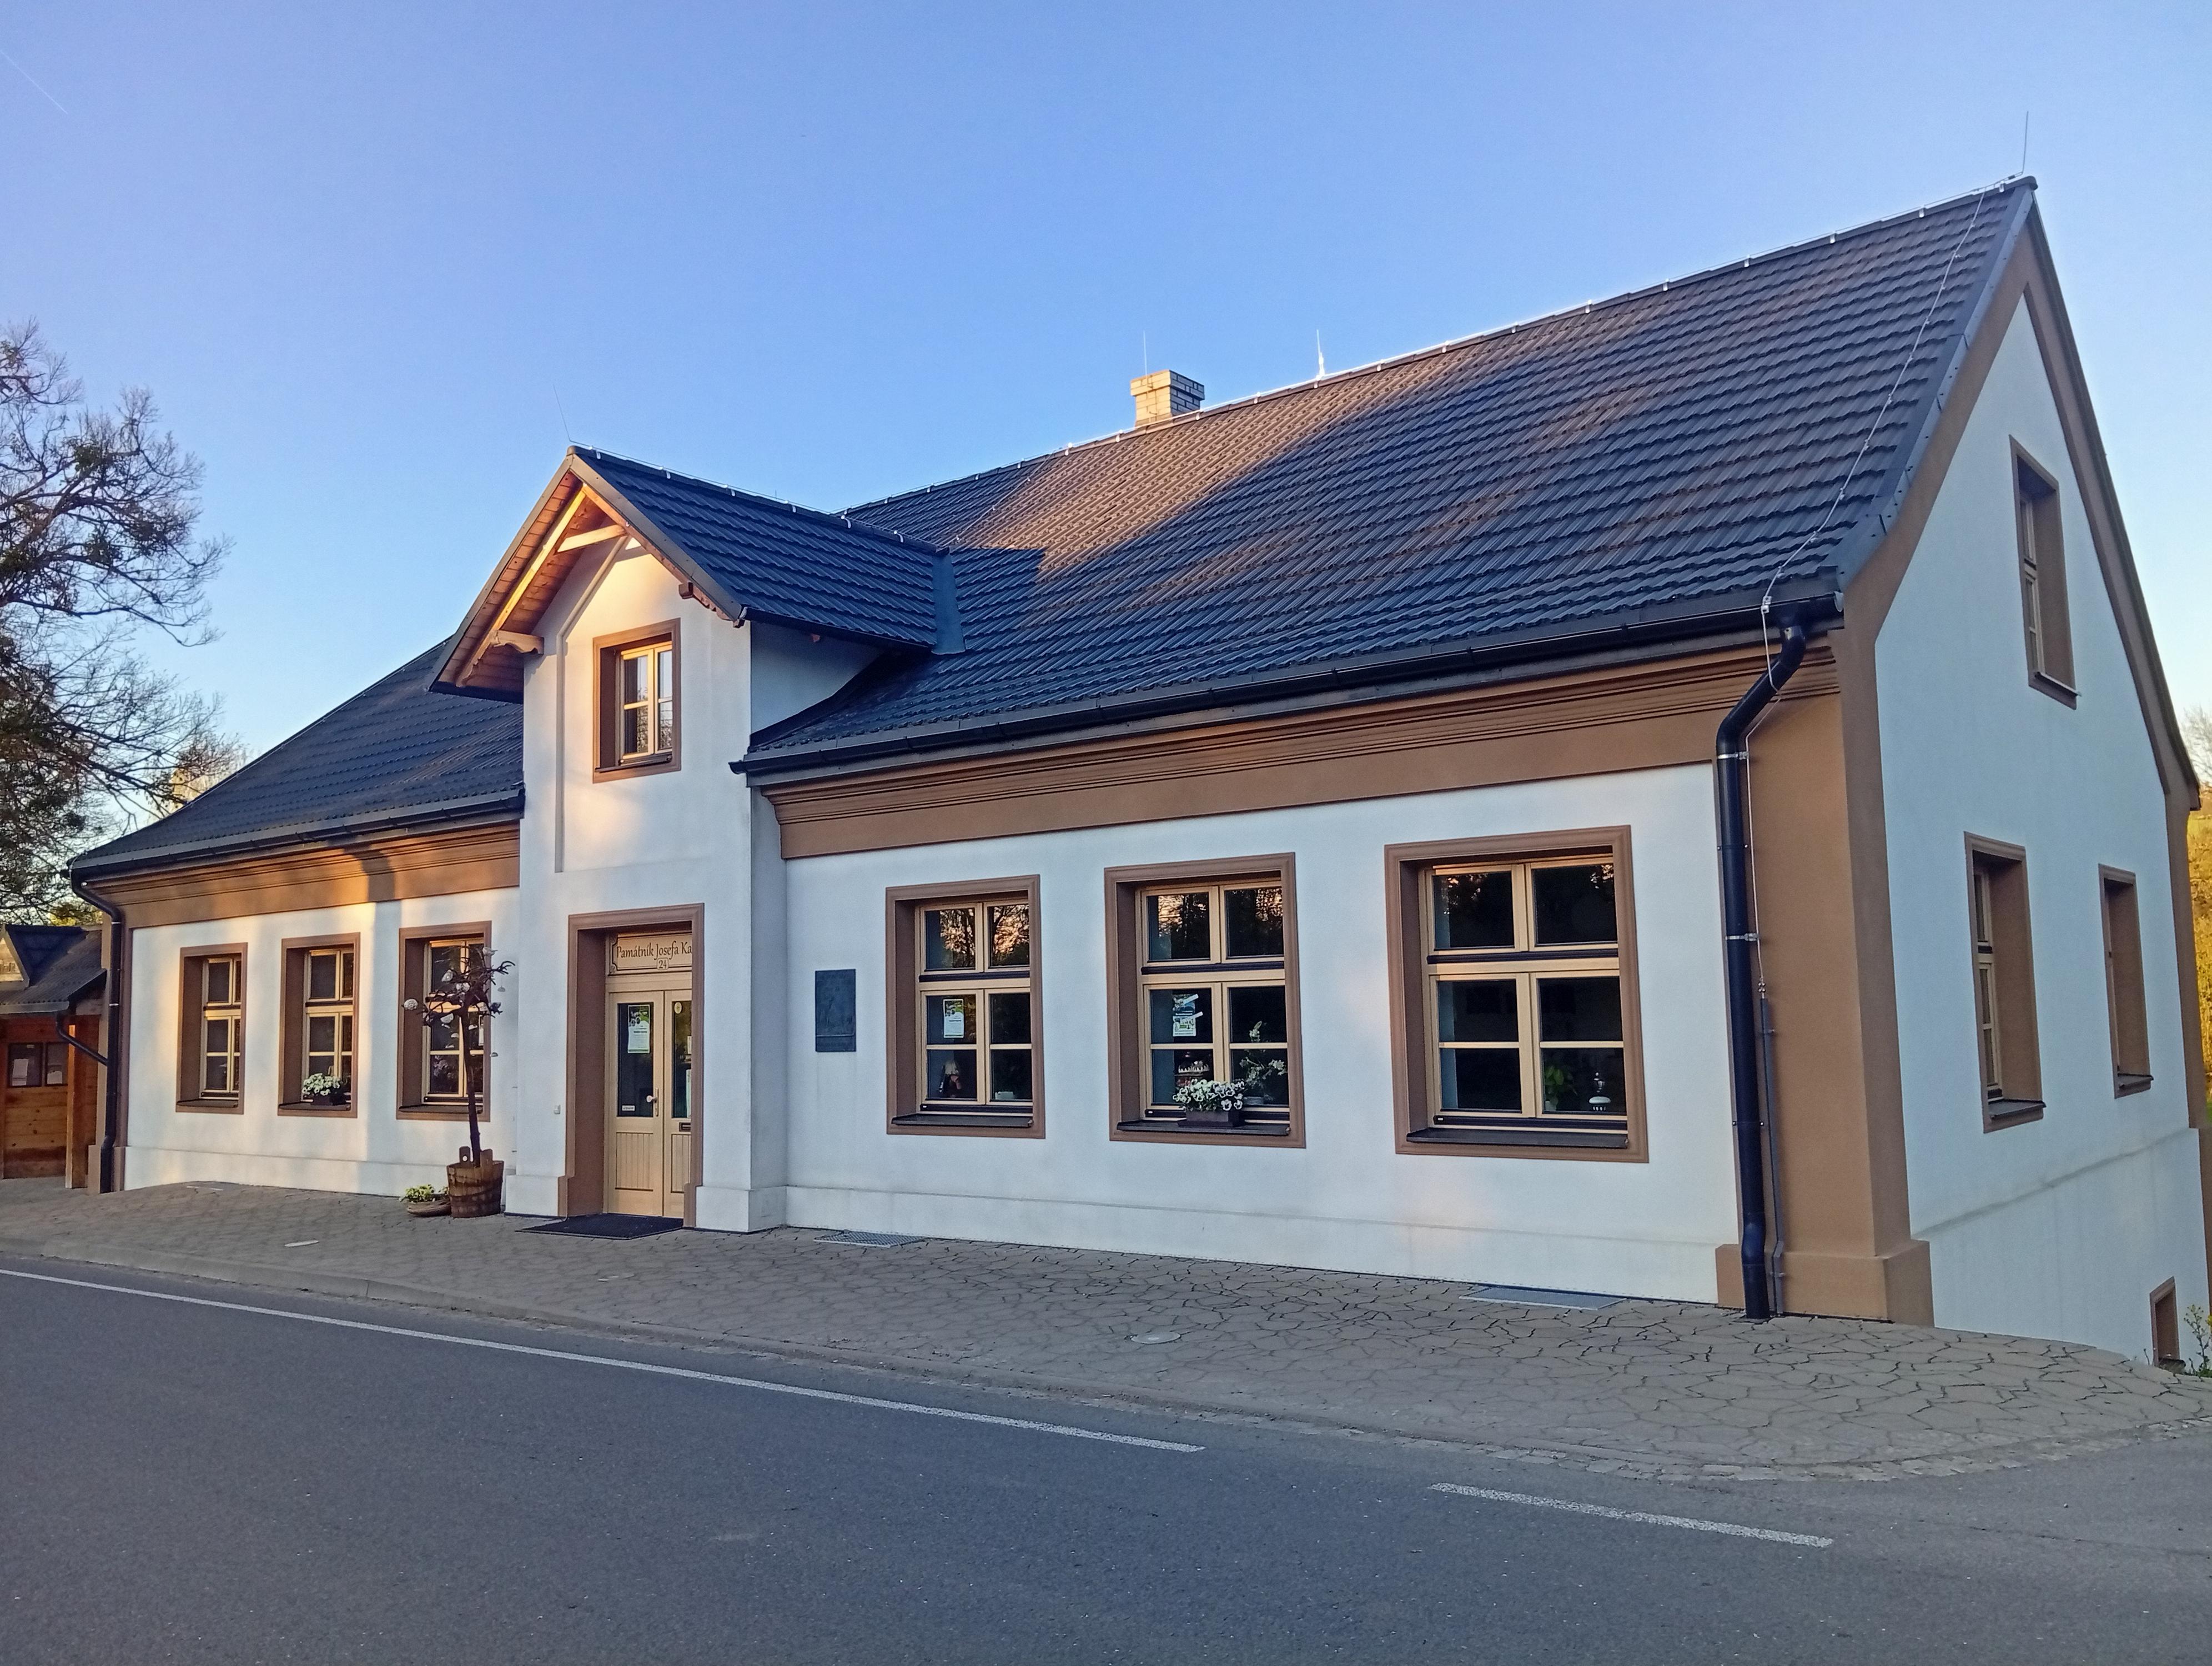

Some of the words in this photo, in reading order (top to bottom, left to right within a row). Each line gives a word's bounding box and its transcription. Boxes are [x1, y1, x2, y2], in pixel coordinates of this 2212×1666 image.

[616, 942, 654, 958] Památník
[653, 940, 679, 960] Josefa
[658, 960, 667, 969] 24
